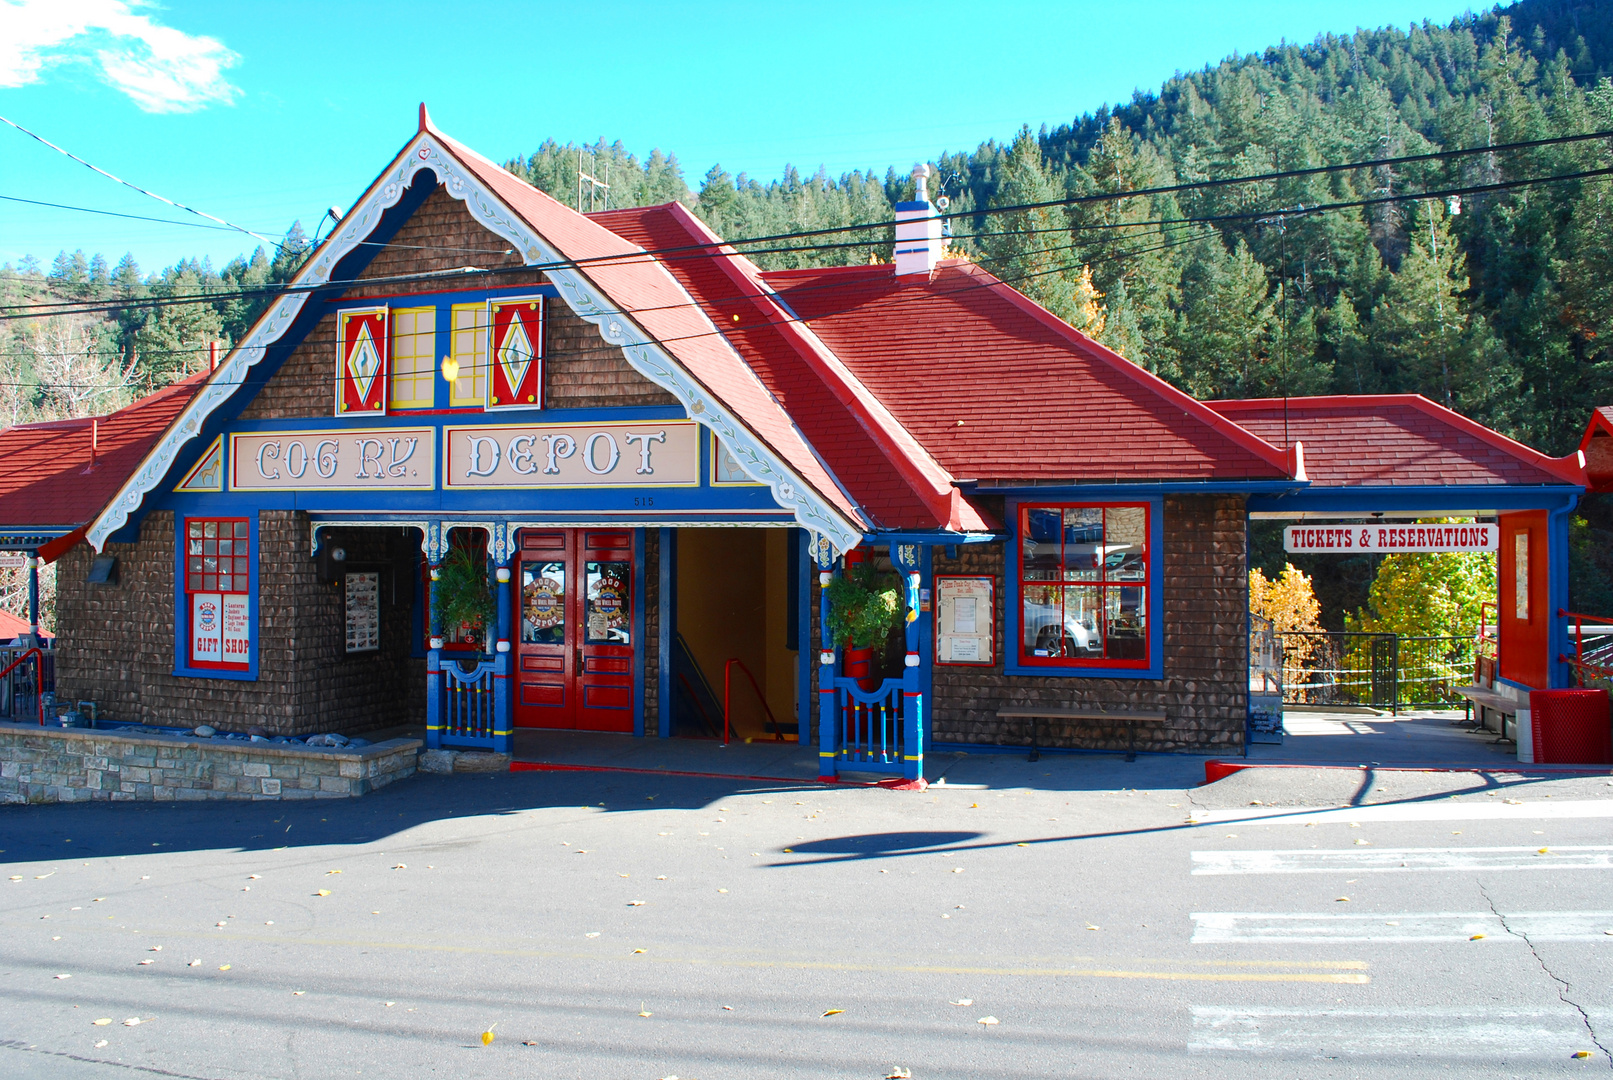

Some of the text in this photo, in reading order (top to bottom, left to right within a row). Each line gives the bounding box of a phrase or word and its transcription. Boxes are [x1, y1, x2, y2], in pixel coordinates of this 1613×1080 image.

[255, 438, 340, 480] COG
[465, 430, 667, 478] DEPOT
[634, 496, 654, 507] 515
[1291, 527, 1489, 548] TICKETS & RESERVATIONS
[530, 615, 558, 627] DEPOT
[197, 637, 250, 654] GIFT SHOP
